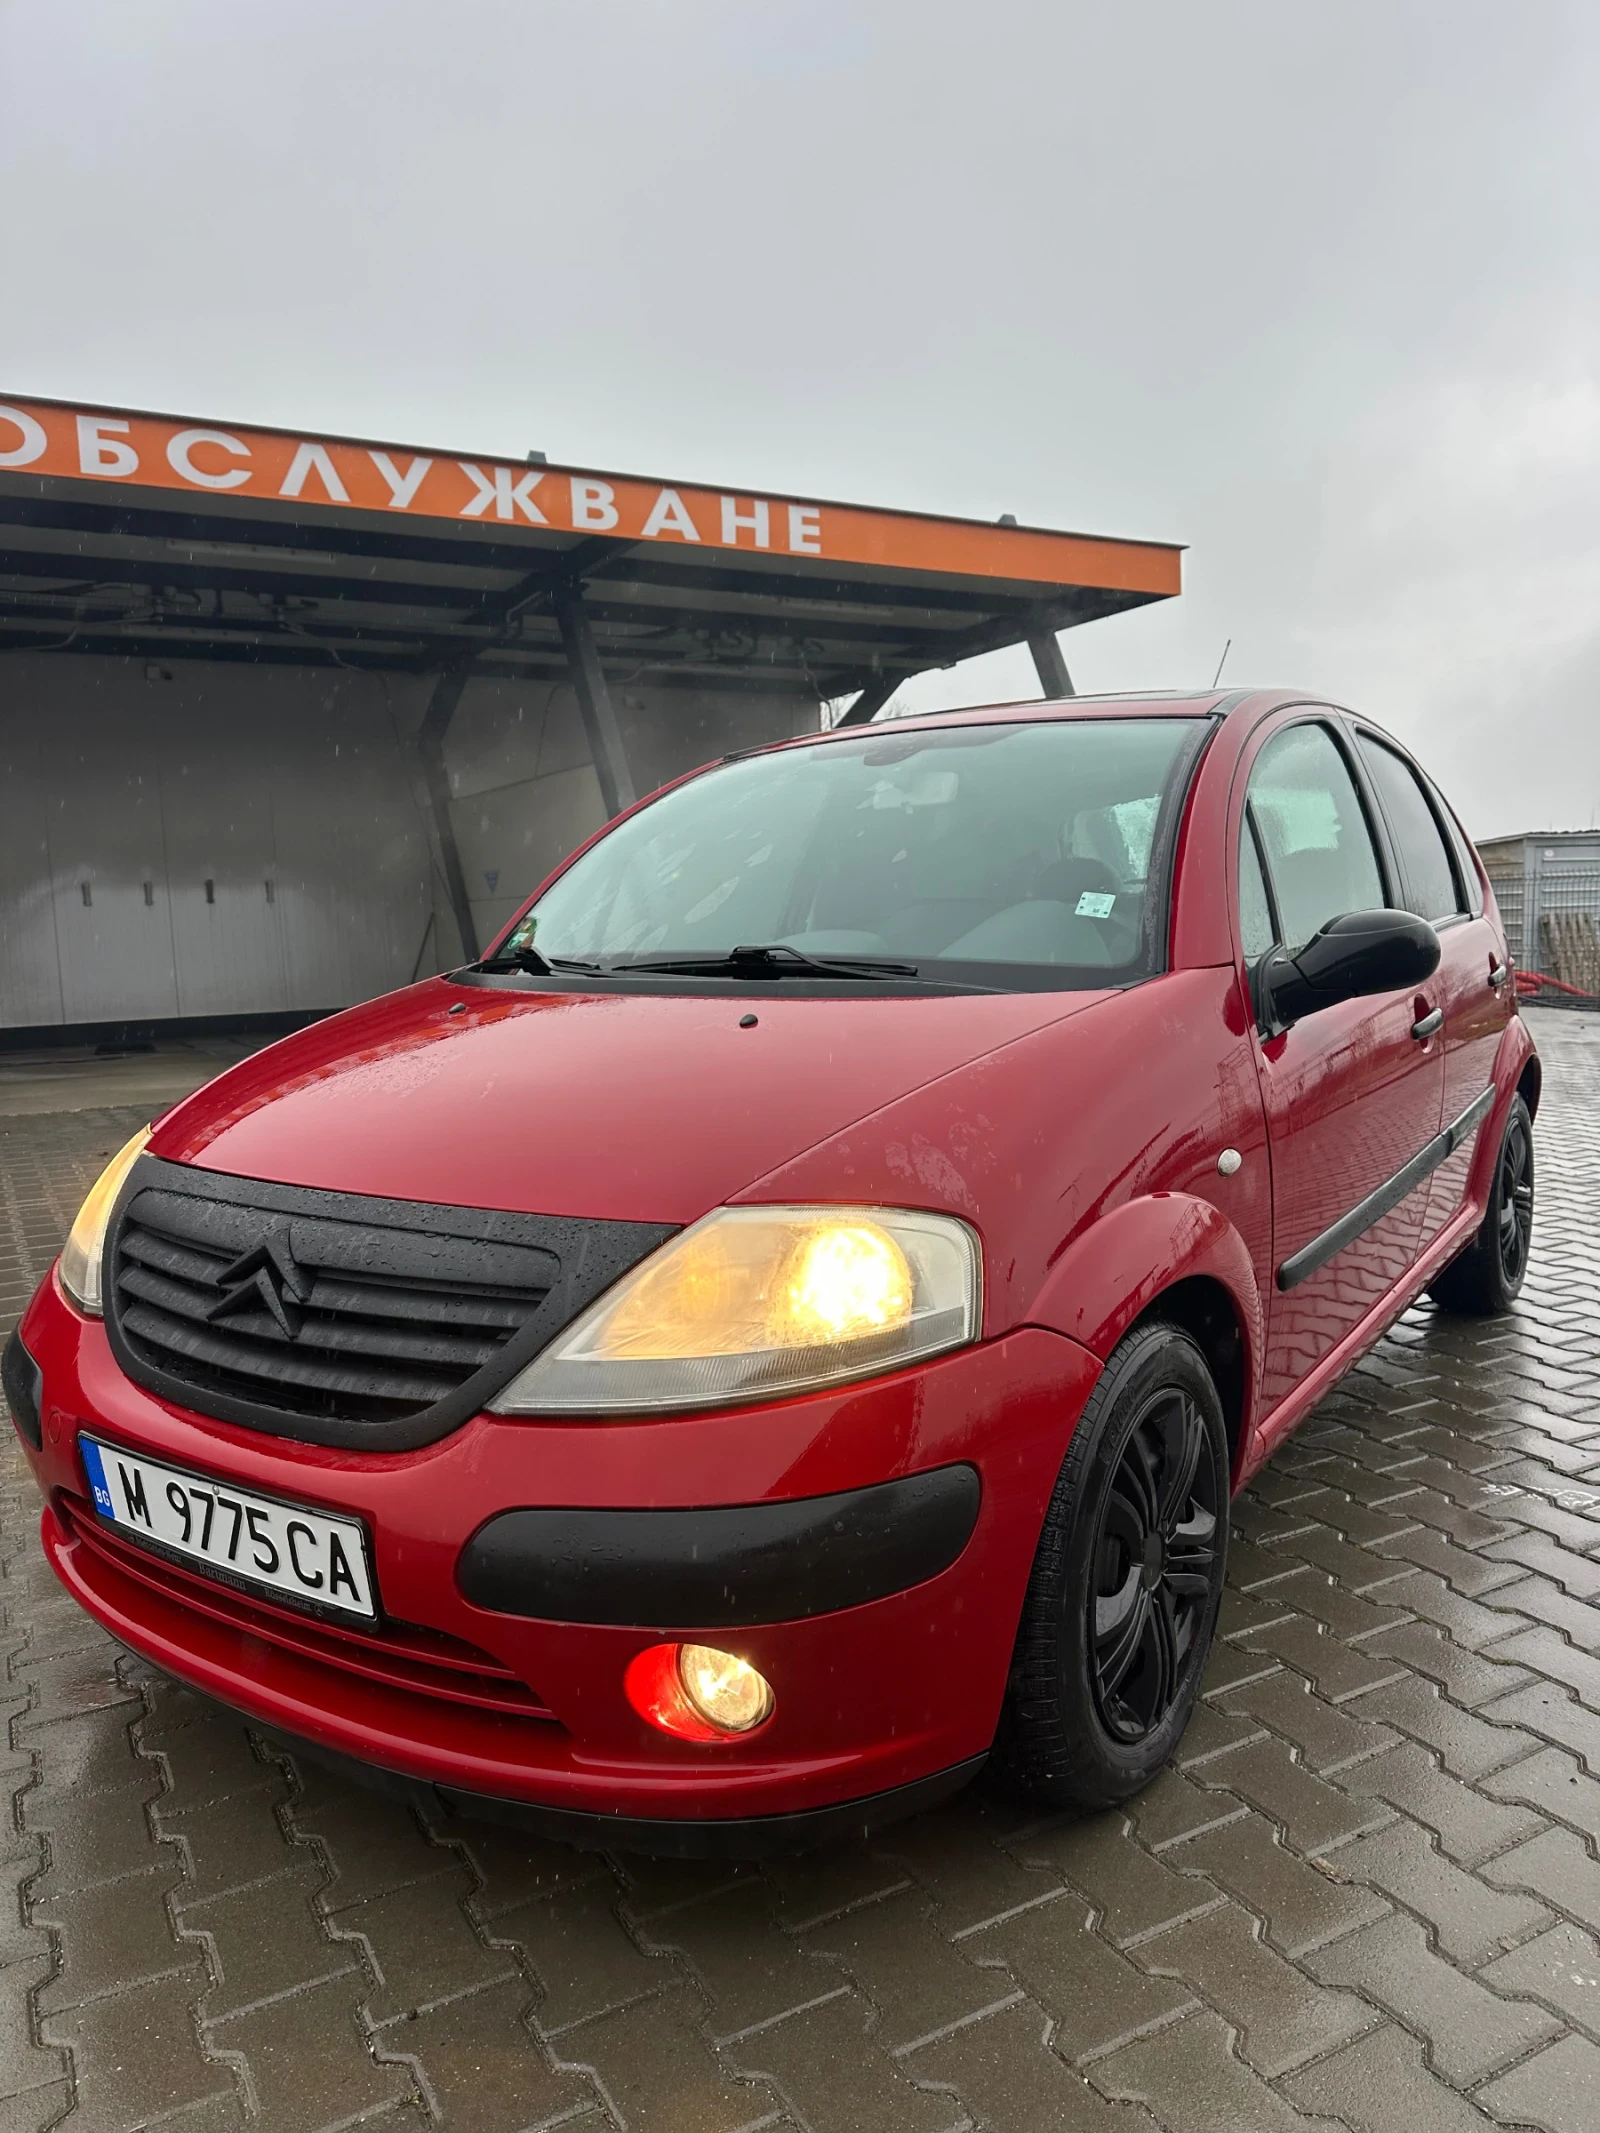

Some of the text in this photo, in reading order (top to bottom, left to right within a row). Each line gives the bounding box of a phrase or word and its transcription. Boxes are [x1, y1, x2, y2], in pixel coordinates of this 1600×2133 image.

[94, 1485, 111, 1508] BG
[117, 1461, 362, 1603] M 9775 CA
[198, 1562, 248, 1591] Bartmann
